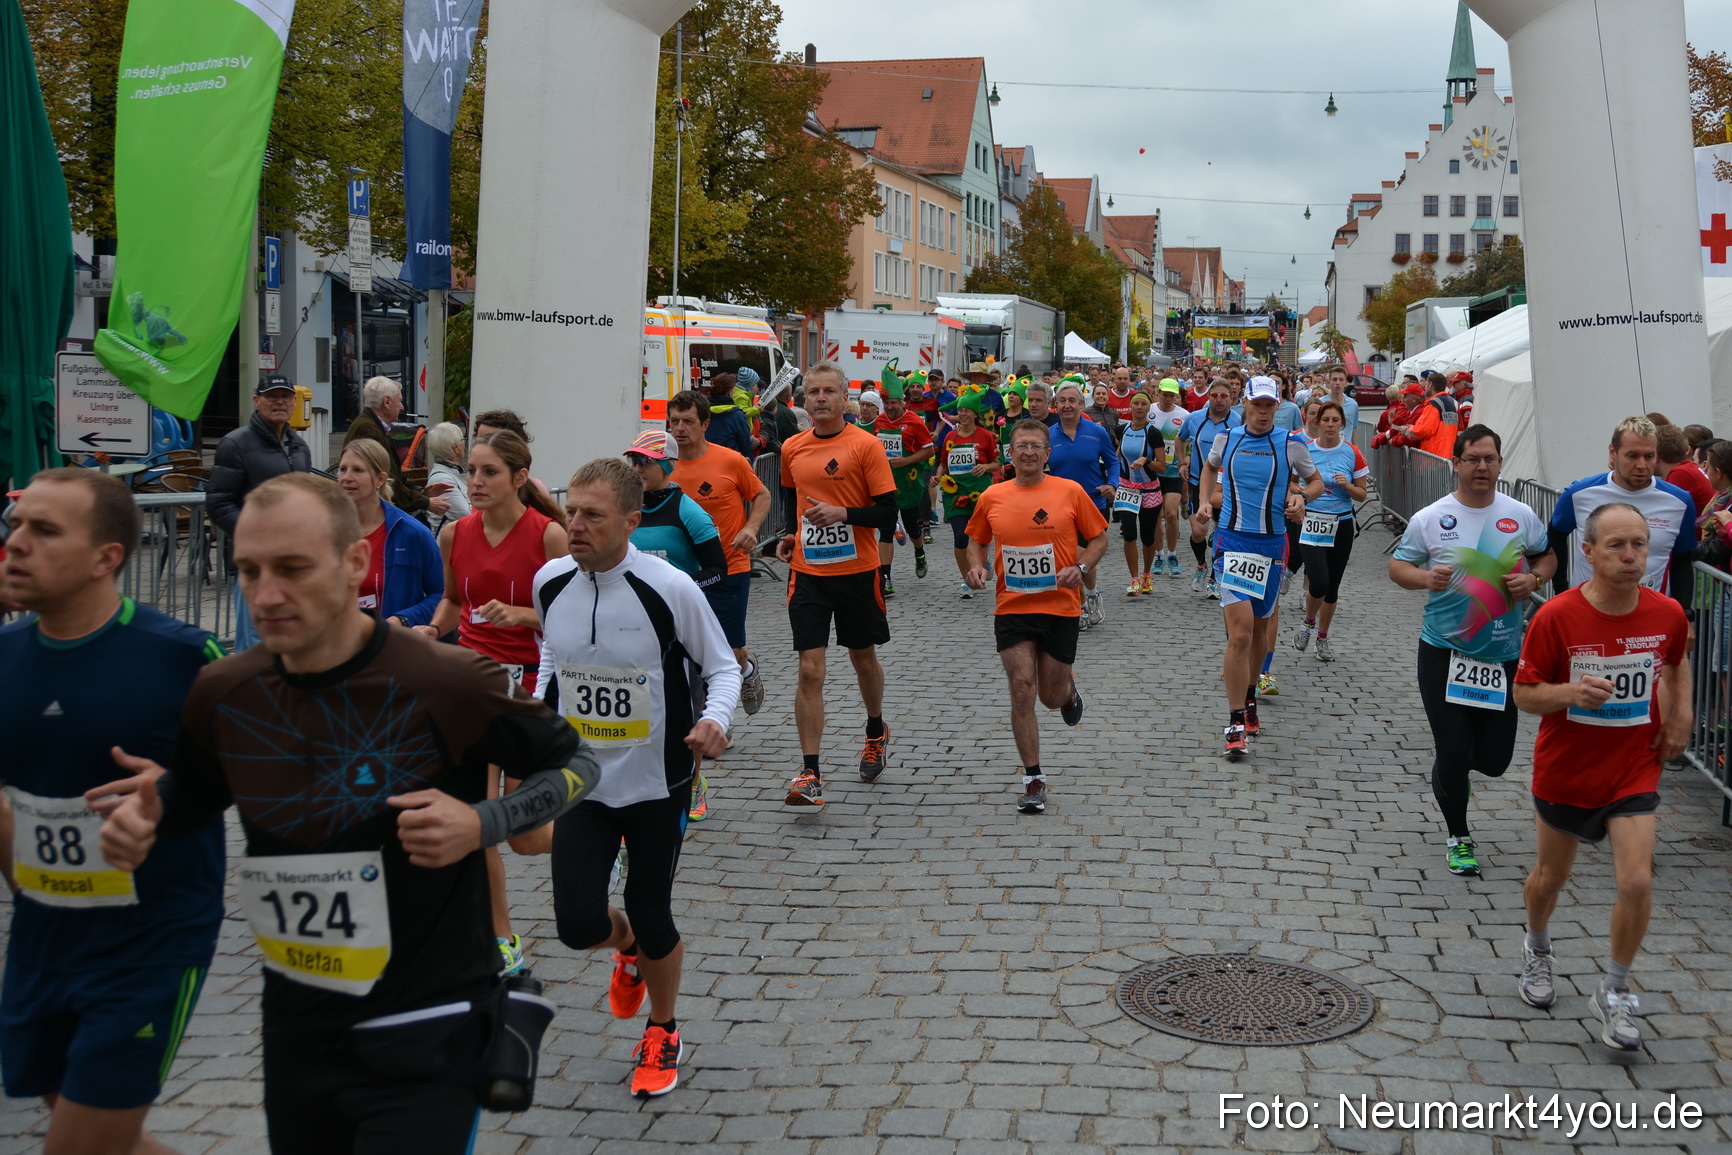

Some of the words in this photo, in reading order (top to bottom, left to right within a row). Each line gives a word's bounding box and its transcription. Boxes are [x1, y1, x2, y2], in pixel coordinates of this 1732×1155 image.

[353, 180, 365, 210] P
[268, 245, 277, 282] P
[302, 307, 309, 322] 3
[477, 309, 614, 326] www.bmw-laufsport.de
[1558, 310, 1703, 330] www.bmw-laufsport.de
[73, 389, 114, 401] Kreuzung
[116, 391, 136, 399] über
[90, 402, 119, 411] Untere
[77, 415, 132, 426] Kaserngasse
[950, 454, 973, 465] 2203
[1116, 491, 1139, 504] 3073
[1306, 520, 1334, 534] 3051
[806, 525, 849, 546] 2255
[815, 548, 842, 558] Michael
[1007, 557, 1051, 575] 2136
[1229, 559, 1265, 582] 2495
[1493, 619, 1504, 628] 16.
[1625, 642, 1660, 650] STADTLAUF
[1626, 634, 1666, 643] NEUMARKTER
[1573, 662, 1602, 671] PARTL
[1603, 662, 1641, 671] Neumarkt
[561, 669, 588, 681] PARTL
[589, 674, 632, 684] Neumarkt
[1454, 663, 1502, 688] 2488
[576, 685, 632, 718] 368
[1463, 689, 1490, 700] Florian
[1591, 707, 1631, 717] Norbert
[580, 723, 626, 737] Thomas
[35, 825, 86, 866] 88
[40, 874, 94, 892] Pascal
[277, 869, 353, 884] Neumarkt
[260, 890, 357, 939] 124
[286, 947, 343, 973] Stefan
